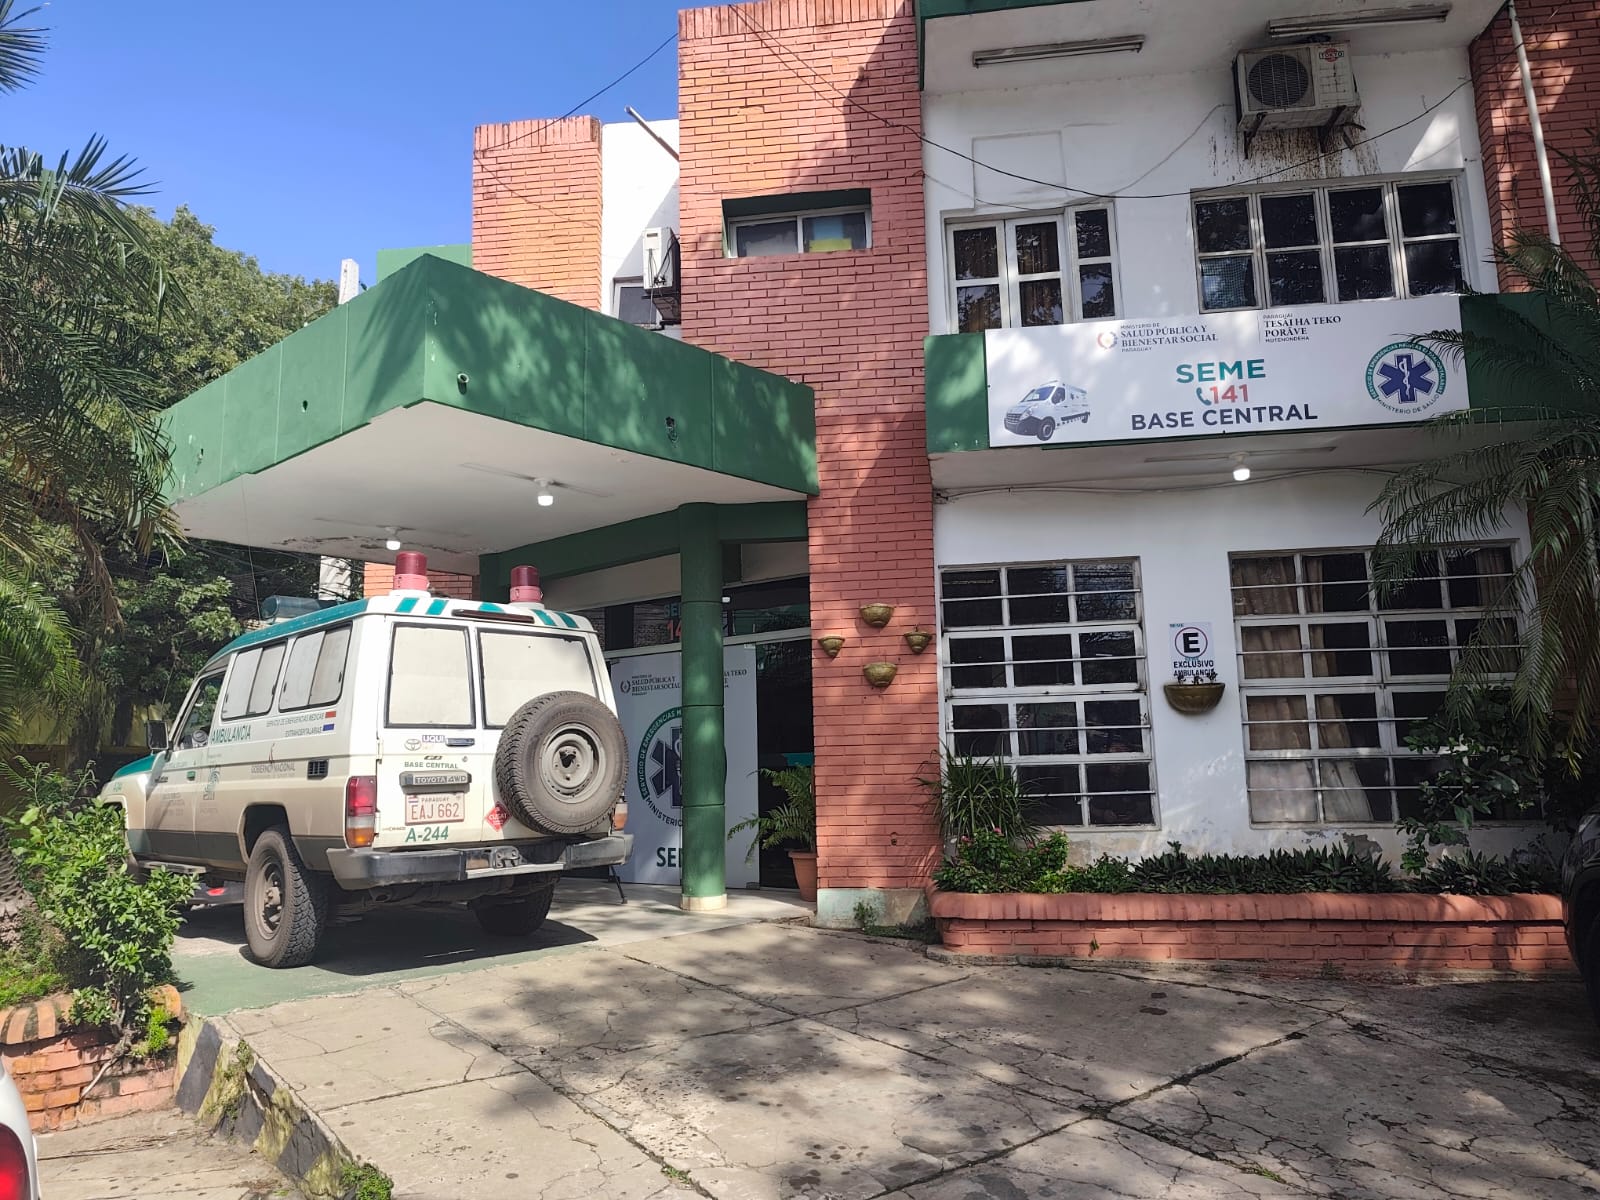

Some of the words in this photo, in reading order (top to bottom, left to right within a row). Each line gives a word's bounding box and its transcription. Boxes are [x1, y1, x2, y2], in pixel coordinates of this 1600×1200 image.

[1312, 315, 1341, 325] TEKO
[1121, 329, 1154, 338] SALUD
[1156, 326, 1199, 336] PÚBLICA
[1200, 325, 1207, 333] Y
[1122, 337, 1179, 347] BIENESTAR
[1180, 333, 1218, 343] SOCIAL
[1176, 359, 1266, 384] SEME
[1209, 384, 1249, 404] 141
[1376, 398, 1411, 414] MINISTERIO
[1131, 411, 1194, 431] BASE
[1202, 404, 1318, 426] CENTRAL
[1183, 632, 1200, 653] E
[1173, 660, 1214, 669] EXCLUSIVO
[211, 725, 251, 744] AMBULANCIA
[642, 709, 676, 749] EMERGENCIAS
[415, 776, 447, 784] TOYOTA
[638, 761, 649, 796] SERVICIO
[411, 803, 434, 820] EAJ
[437, 803, 459, 818] 662
[405, 826, 449, 842] A-244
[656, 847, 682, 868] SE
